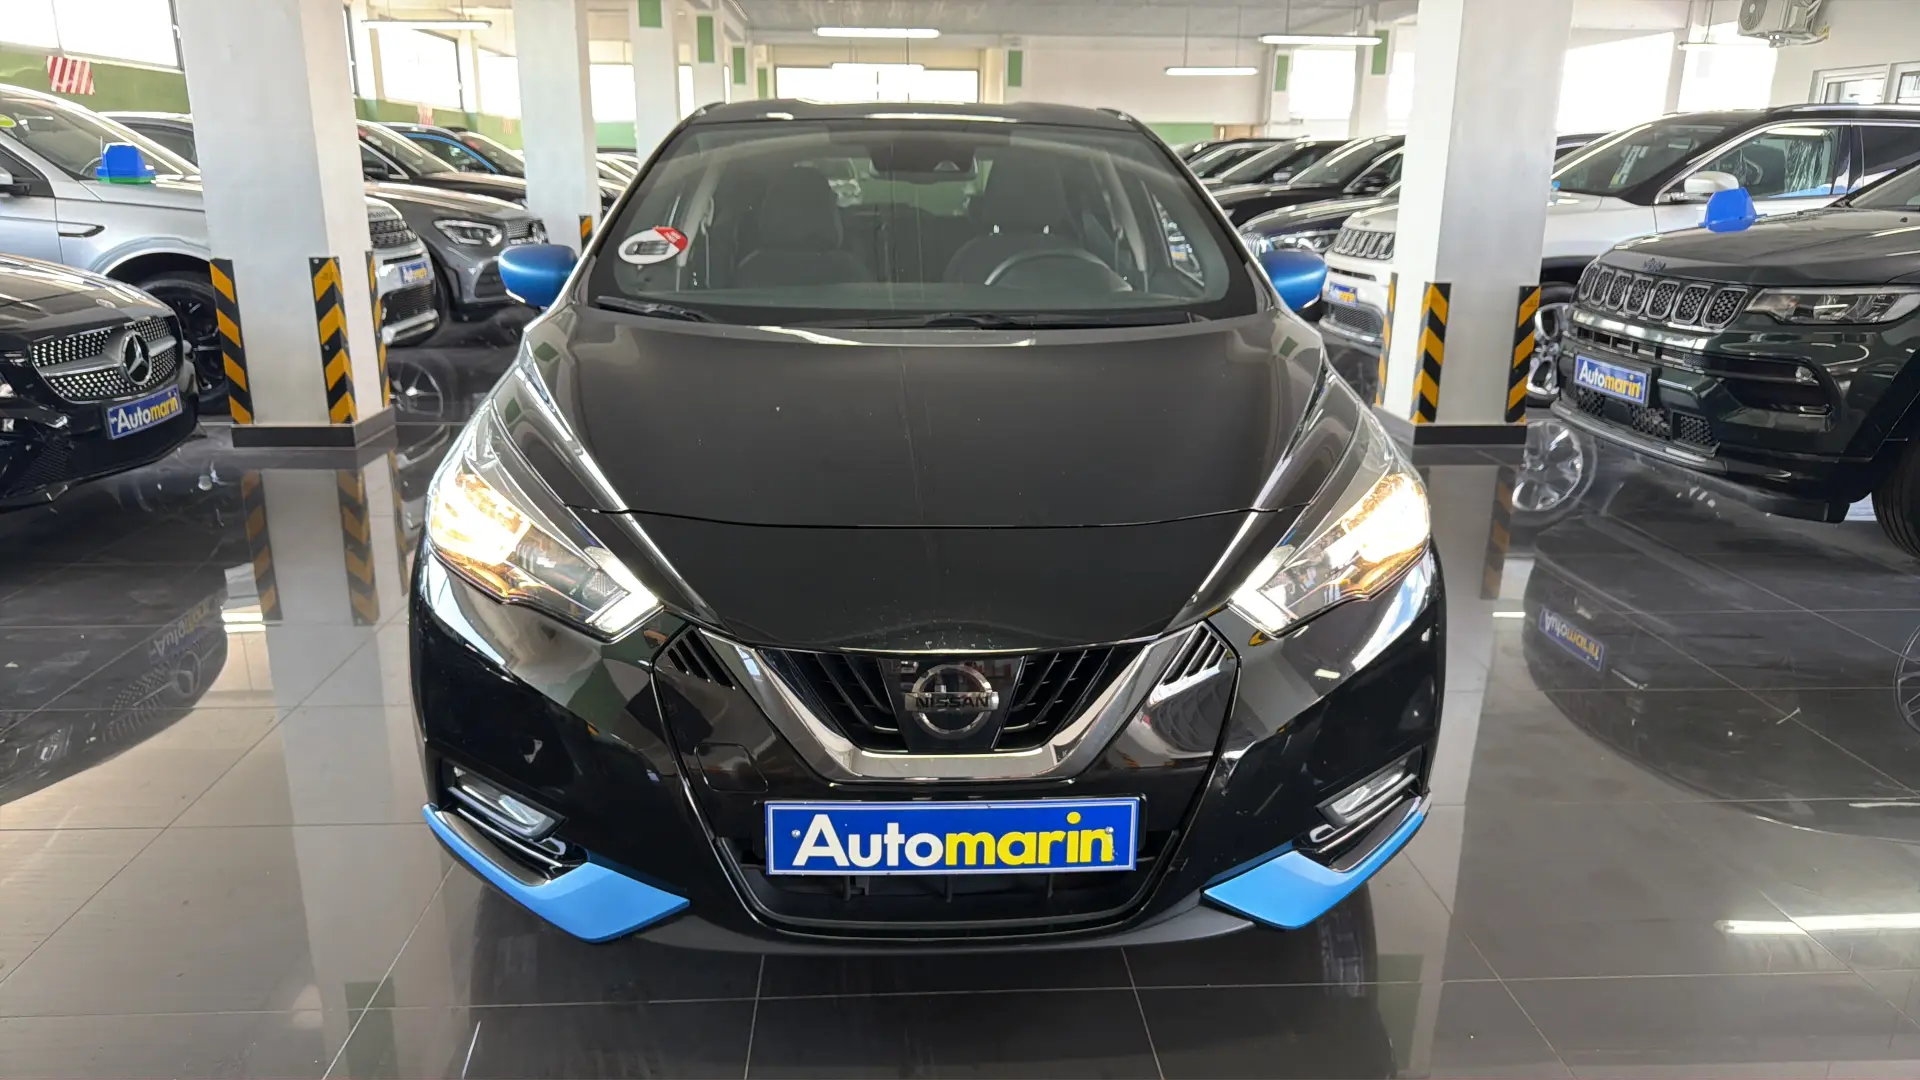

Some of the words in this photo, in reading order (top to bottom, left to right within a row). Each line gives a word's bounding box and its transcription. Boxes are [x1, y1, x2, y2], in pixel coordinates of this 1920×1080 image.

[1579, 360, 1641, 398] Automarin
[117, 391, 179, 433] Automarin
[915, 696, 989, 708] NISSAN
[792, 812, 1114, 867] Automarin
